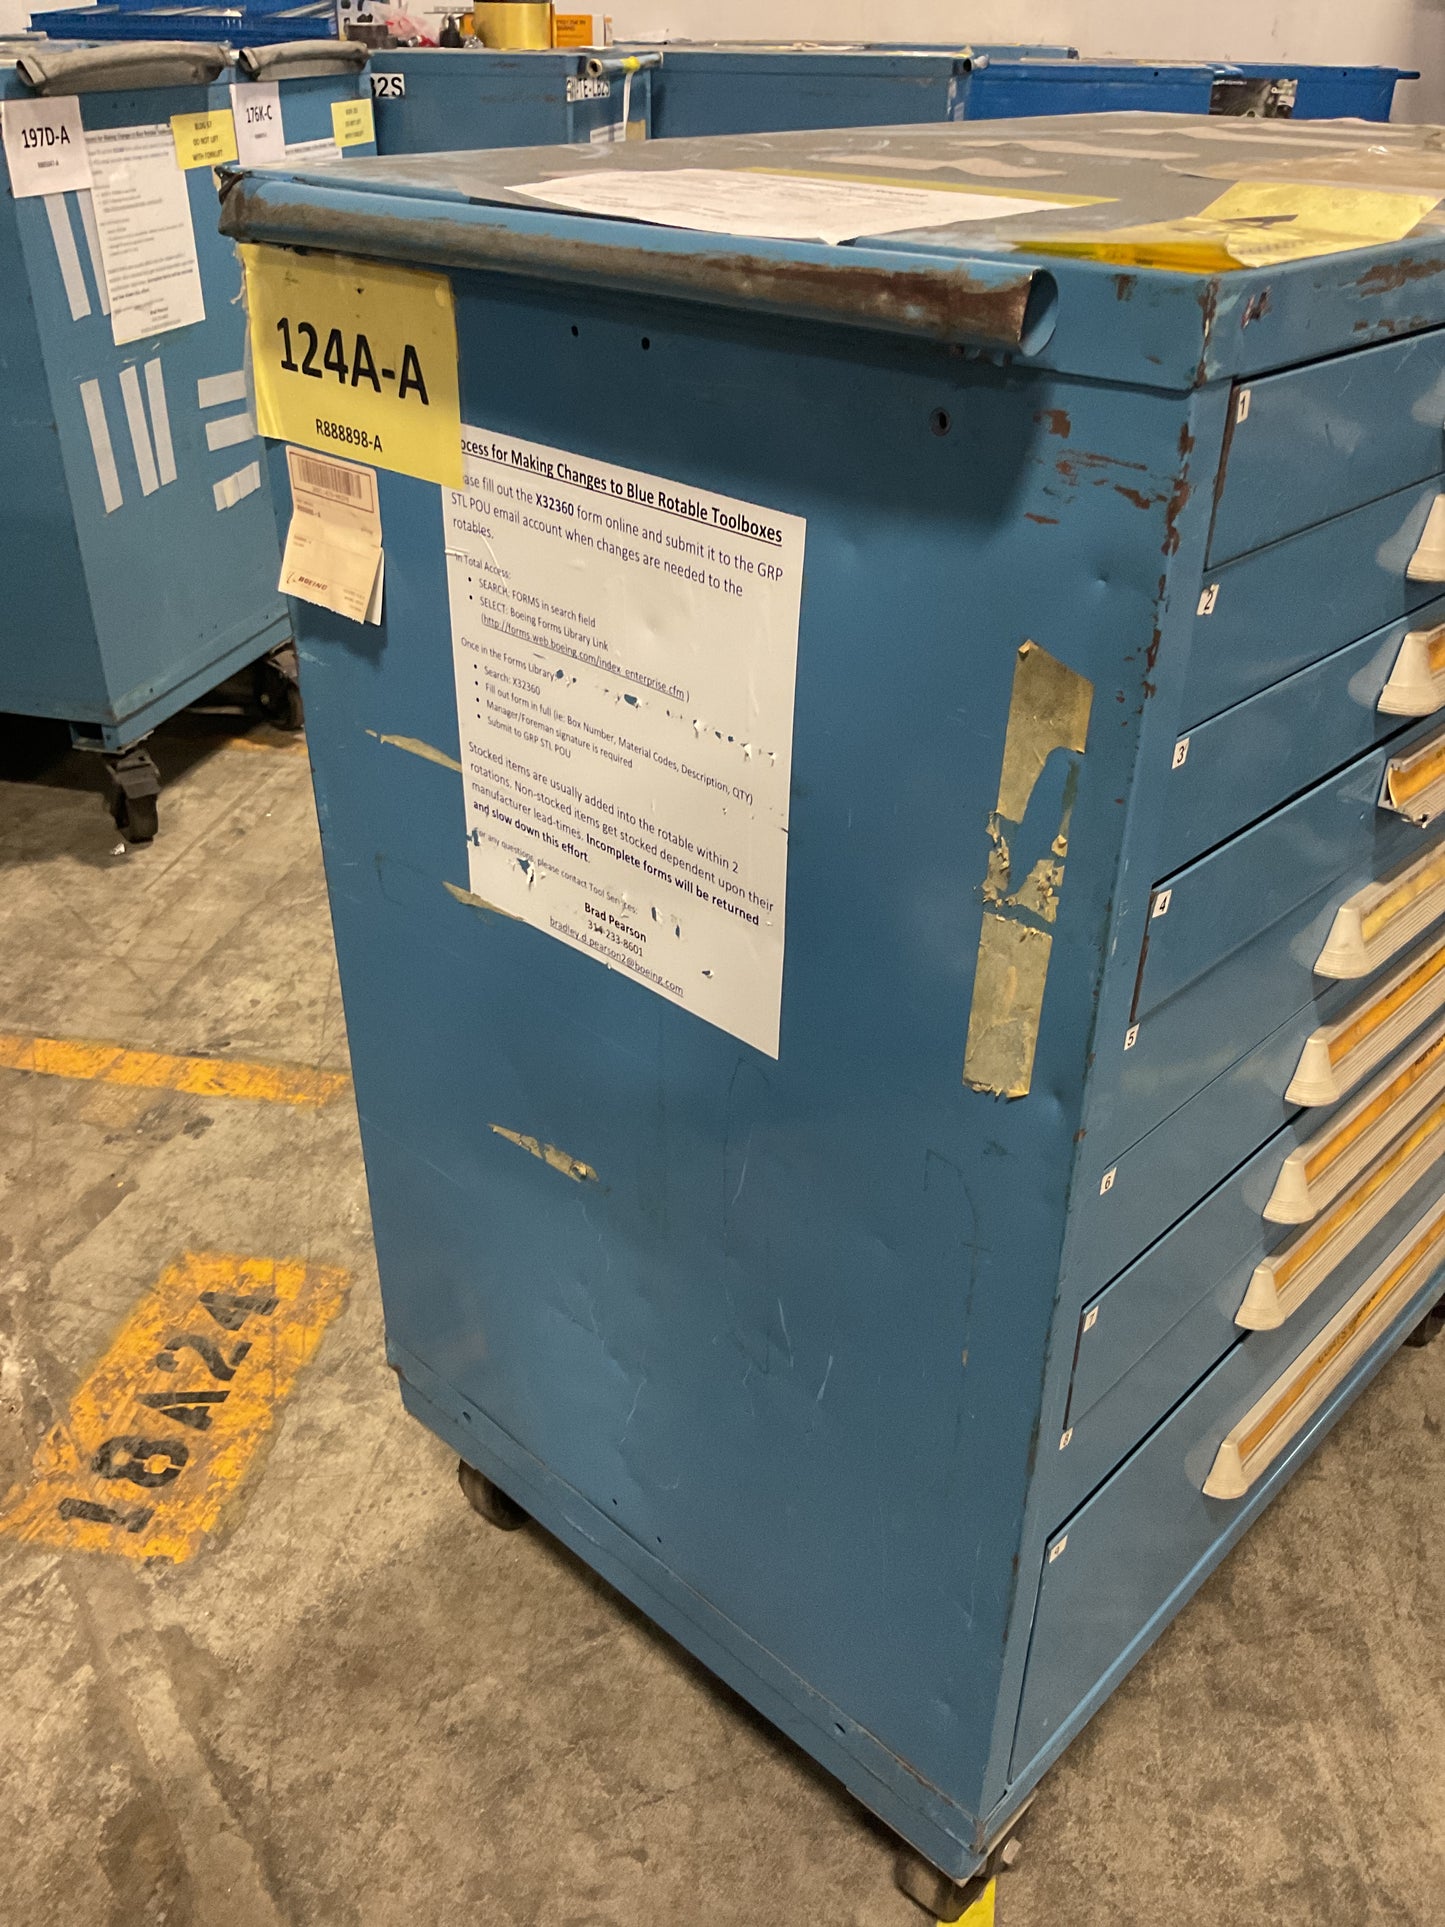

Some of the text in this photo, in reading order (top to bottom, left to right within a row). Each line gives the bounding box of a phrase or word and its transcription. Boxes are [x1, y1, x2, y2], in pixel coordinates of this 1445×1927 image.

[246, 104, 273, 124] 176K-C
[21, 125, 71, 149] 197D-A
[277, 317, 430, 406] 124A-A
[1240, 396, 1246, 416] 1
[315, 418, 383, 453] R888898-A
[460, 439, 782, 542] ocess for Making Changes to Blue Rotable Toolboxes
[451, 492, 743, 596] STL POU email account when changes are needed to the
[453, 518, 492, 538] rotables.
[464, 475, 480, 488] ase
[482, 476, 495, 492] fill
[496, 484, 514, 498] out
[515, 488, 533, 503] the
[535, 493, 574, 516] X32360
[576, 505, 603, 525] form
[605, 517, 639, 536] online
[641, 528, 663, 543] and
[665, 536, 704, 557] submit
[718, 551, 731, 565] to
[734, 555, 754, 573] the
[757, 562, 783, 581] GRP
[464, 554, 483, 568] Total
[484, 561, 509, 578] Access:
[511, 590, 540, 608] FORMS
[541, 600, 550, 611] in
[550, 605, 577, 621] search
[577, 612, 596, 627] field
[1204, 591, 1214, 610] 2
[510, 607, 537, 627] Boeing
[537, 617, 562, 634] Forms
[563, 626, 591, 646] Library
[592, 637, 609, 651] Link
[460, 637, 480, 652] Once
[489, 648, 502, 660] the
[503, 653, 527, 669] Forms
[512, 677, 541, 695] X32360
[485, 682, 496, 693] Fill
[497, 689, 510, 699] out
[511, 692, 530, 707] form
[539, 704, 552, 716] full
[567, 715, 581, 727] Box
[583, 722, 614, 741] Number,
[618, 737, 652, 758] Material
[652, 752, 679, 772] Codes,
[681, 764, 731, 795] Description,
[732, 787, 753, 805] QTY)
[486, 699, 555, 734] Manager/Foreman
[555, 730, 591, 750] signature
[600, 748, 633, 768] required
[487, 716, 571, 758] Submit to GRP STL POU
[1177, 746, 1185, 763] 3
[468, 741, 504, 765] Stocked
[505, 759, 531, 777] items
[532, 771, 548, 784] are
[550, 779, 583, 802] usually
[584, 795, 615, 814] added
[617, 810, 636, 824] into
[638, 818, 655, 833] the
[657, 828, 694, 852] rotable
[696, 847, 729, 868] within
[473, 801, 490, 815] and
[491, 809, 513, 825] slow
[514, 819, 540, 838] down
[542, 832, 560, 847] this
[470, 763, 774, 911] rotations. Non-stocked items get stocked dependent upon their
[471, 782, 759, 925] manufacturer lead-times. Incomplete forms will be returned
[537, 858, 560, 874] please
[560, 871, 588, 888] contact
[588, 882, 605, 897] Tool
[584, 902, 647, 942] Brad Pearson
[1159, 896, 1168, 912] 4
[1127, 1031, 1135, 1046] 5
[1104, 1176, 1111, 1190] 6
[58, 1291, 279, 1533] 18A24
